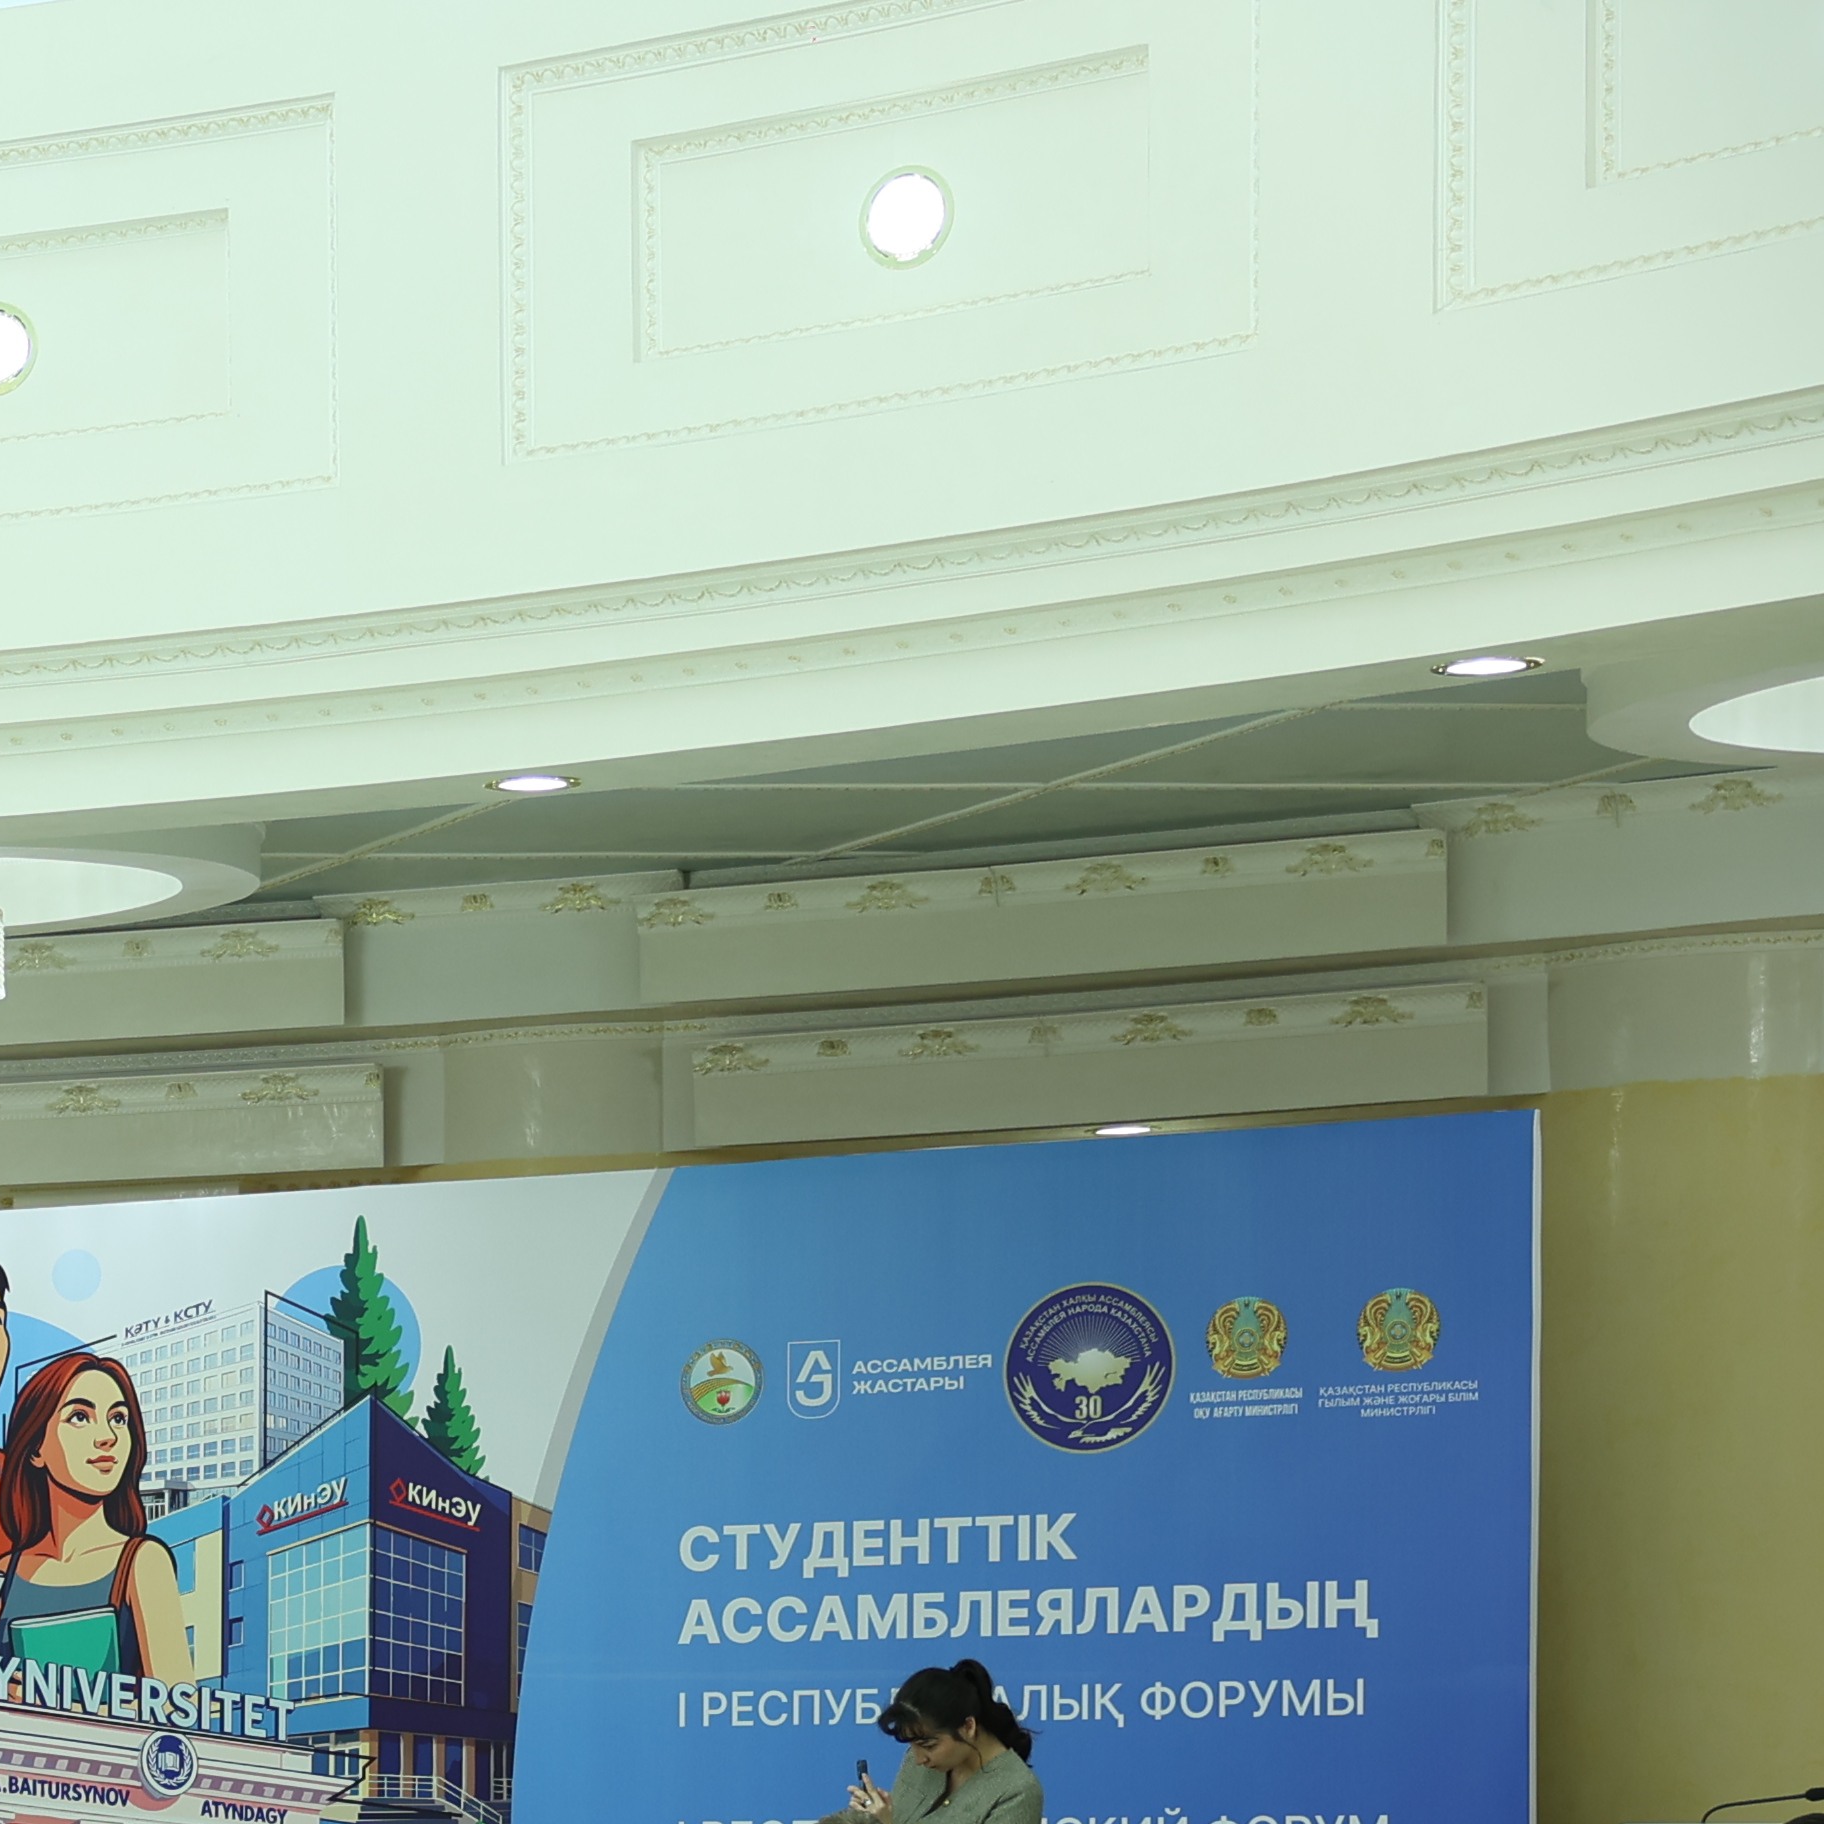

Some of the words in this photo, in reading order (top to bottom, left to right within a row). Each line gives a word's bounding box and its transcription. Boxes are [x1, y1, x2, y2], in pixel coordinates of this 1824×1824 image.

[1026, 1311, 1067, 1363] АССАМБЛЕЯ
[1068, 1303, 1109, 1316] НАРОДА
[1110, 1307, 1153, 1358] КАЗАХСТАНА
[1098, 1294, 1159, 1344] АССАМБЛЕЯСЫ
[852, 1353, 993, 1375] АССАМБЛЕЯ
[852, 1376, 965, 1395] ЖАСТАРЫ
[1074, 1395, 1103, 1419] 30
[678, 1512, 1078, 1578] СТУДЕНТТІК
[677, 1579, 1380, 1645] АССАМБЛЕЯЛАРДЫҢ
[702, 1683, 1126, 1729] РЕСПУБЛЫҚ
[1140, 1677, 1365, 1722] ФОРУМЫ
